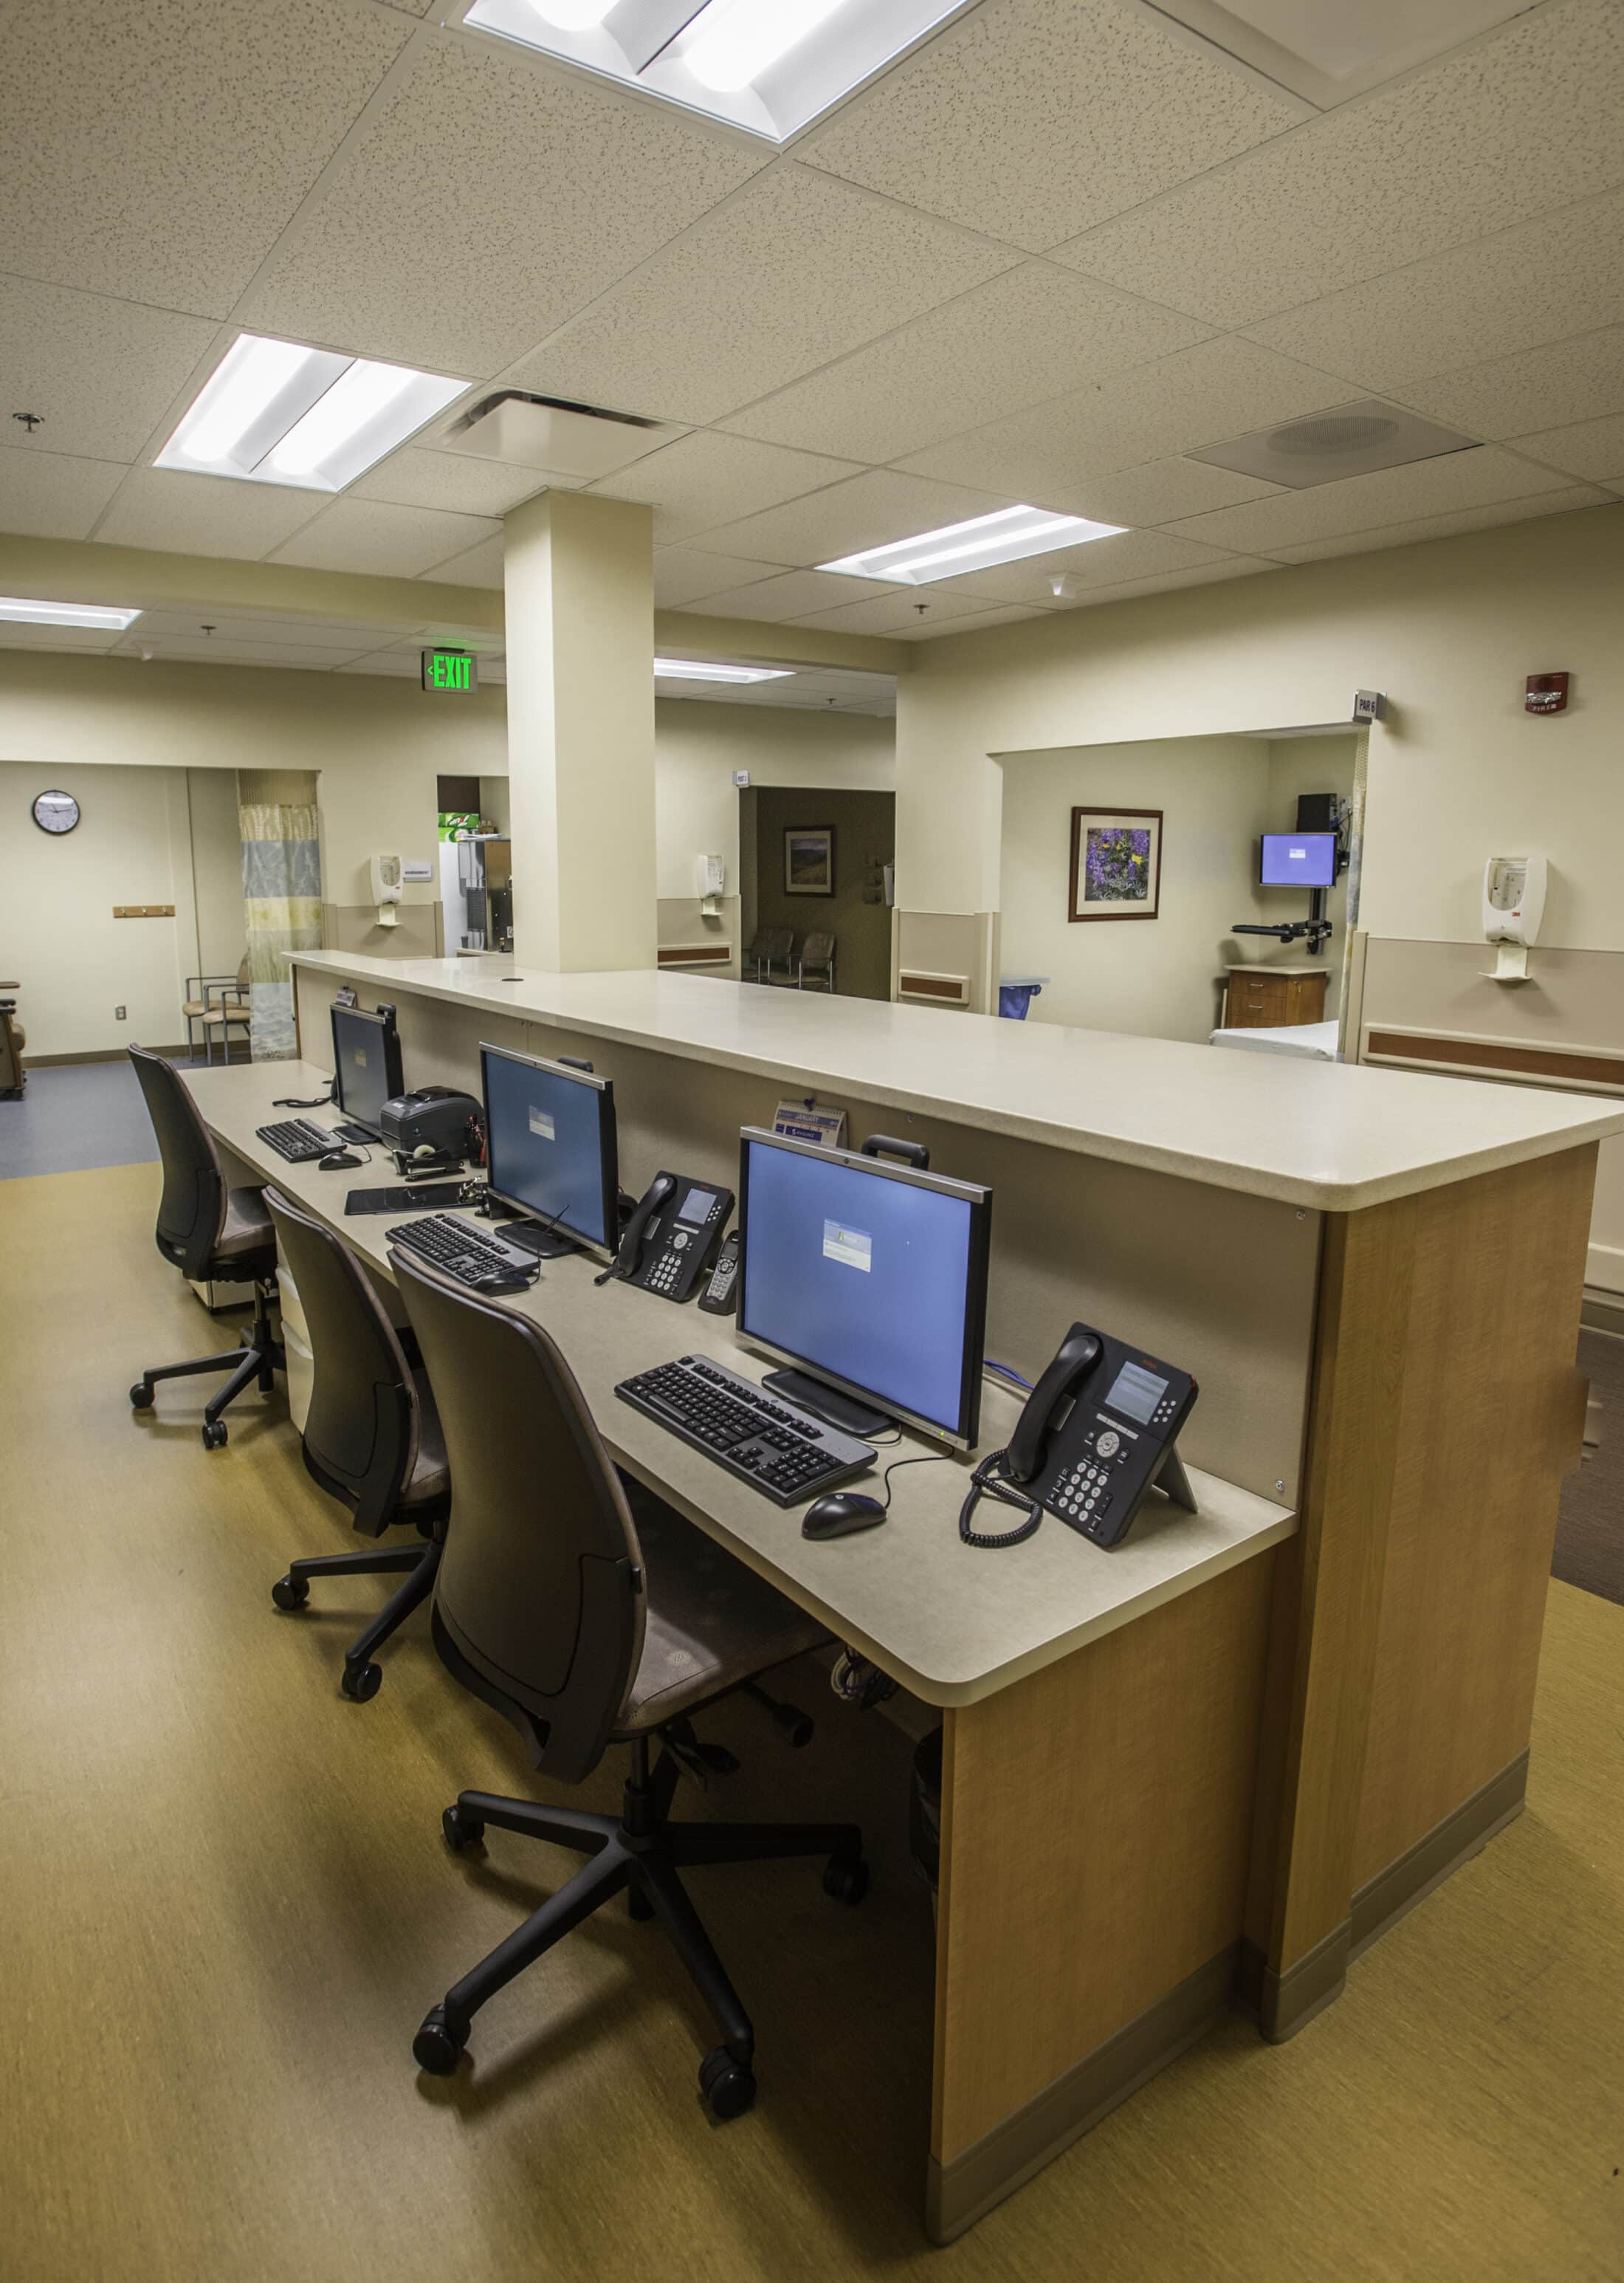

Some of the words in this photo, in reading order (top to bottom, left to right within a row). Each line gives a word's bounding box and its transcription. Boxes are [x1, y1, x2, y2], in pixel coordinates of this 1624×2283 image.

[433, 655, 472, 690] EXIT
[1359, 698, 1371, 712] PAR
[1371, 701, 1376, 713] 6
[795, 1113, 819, 1123] JANUARY
